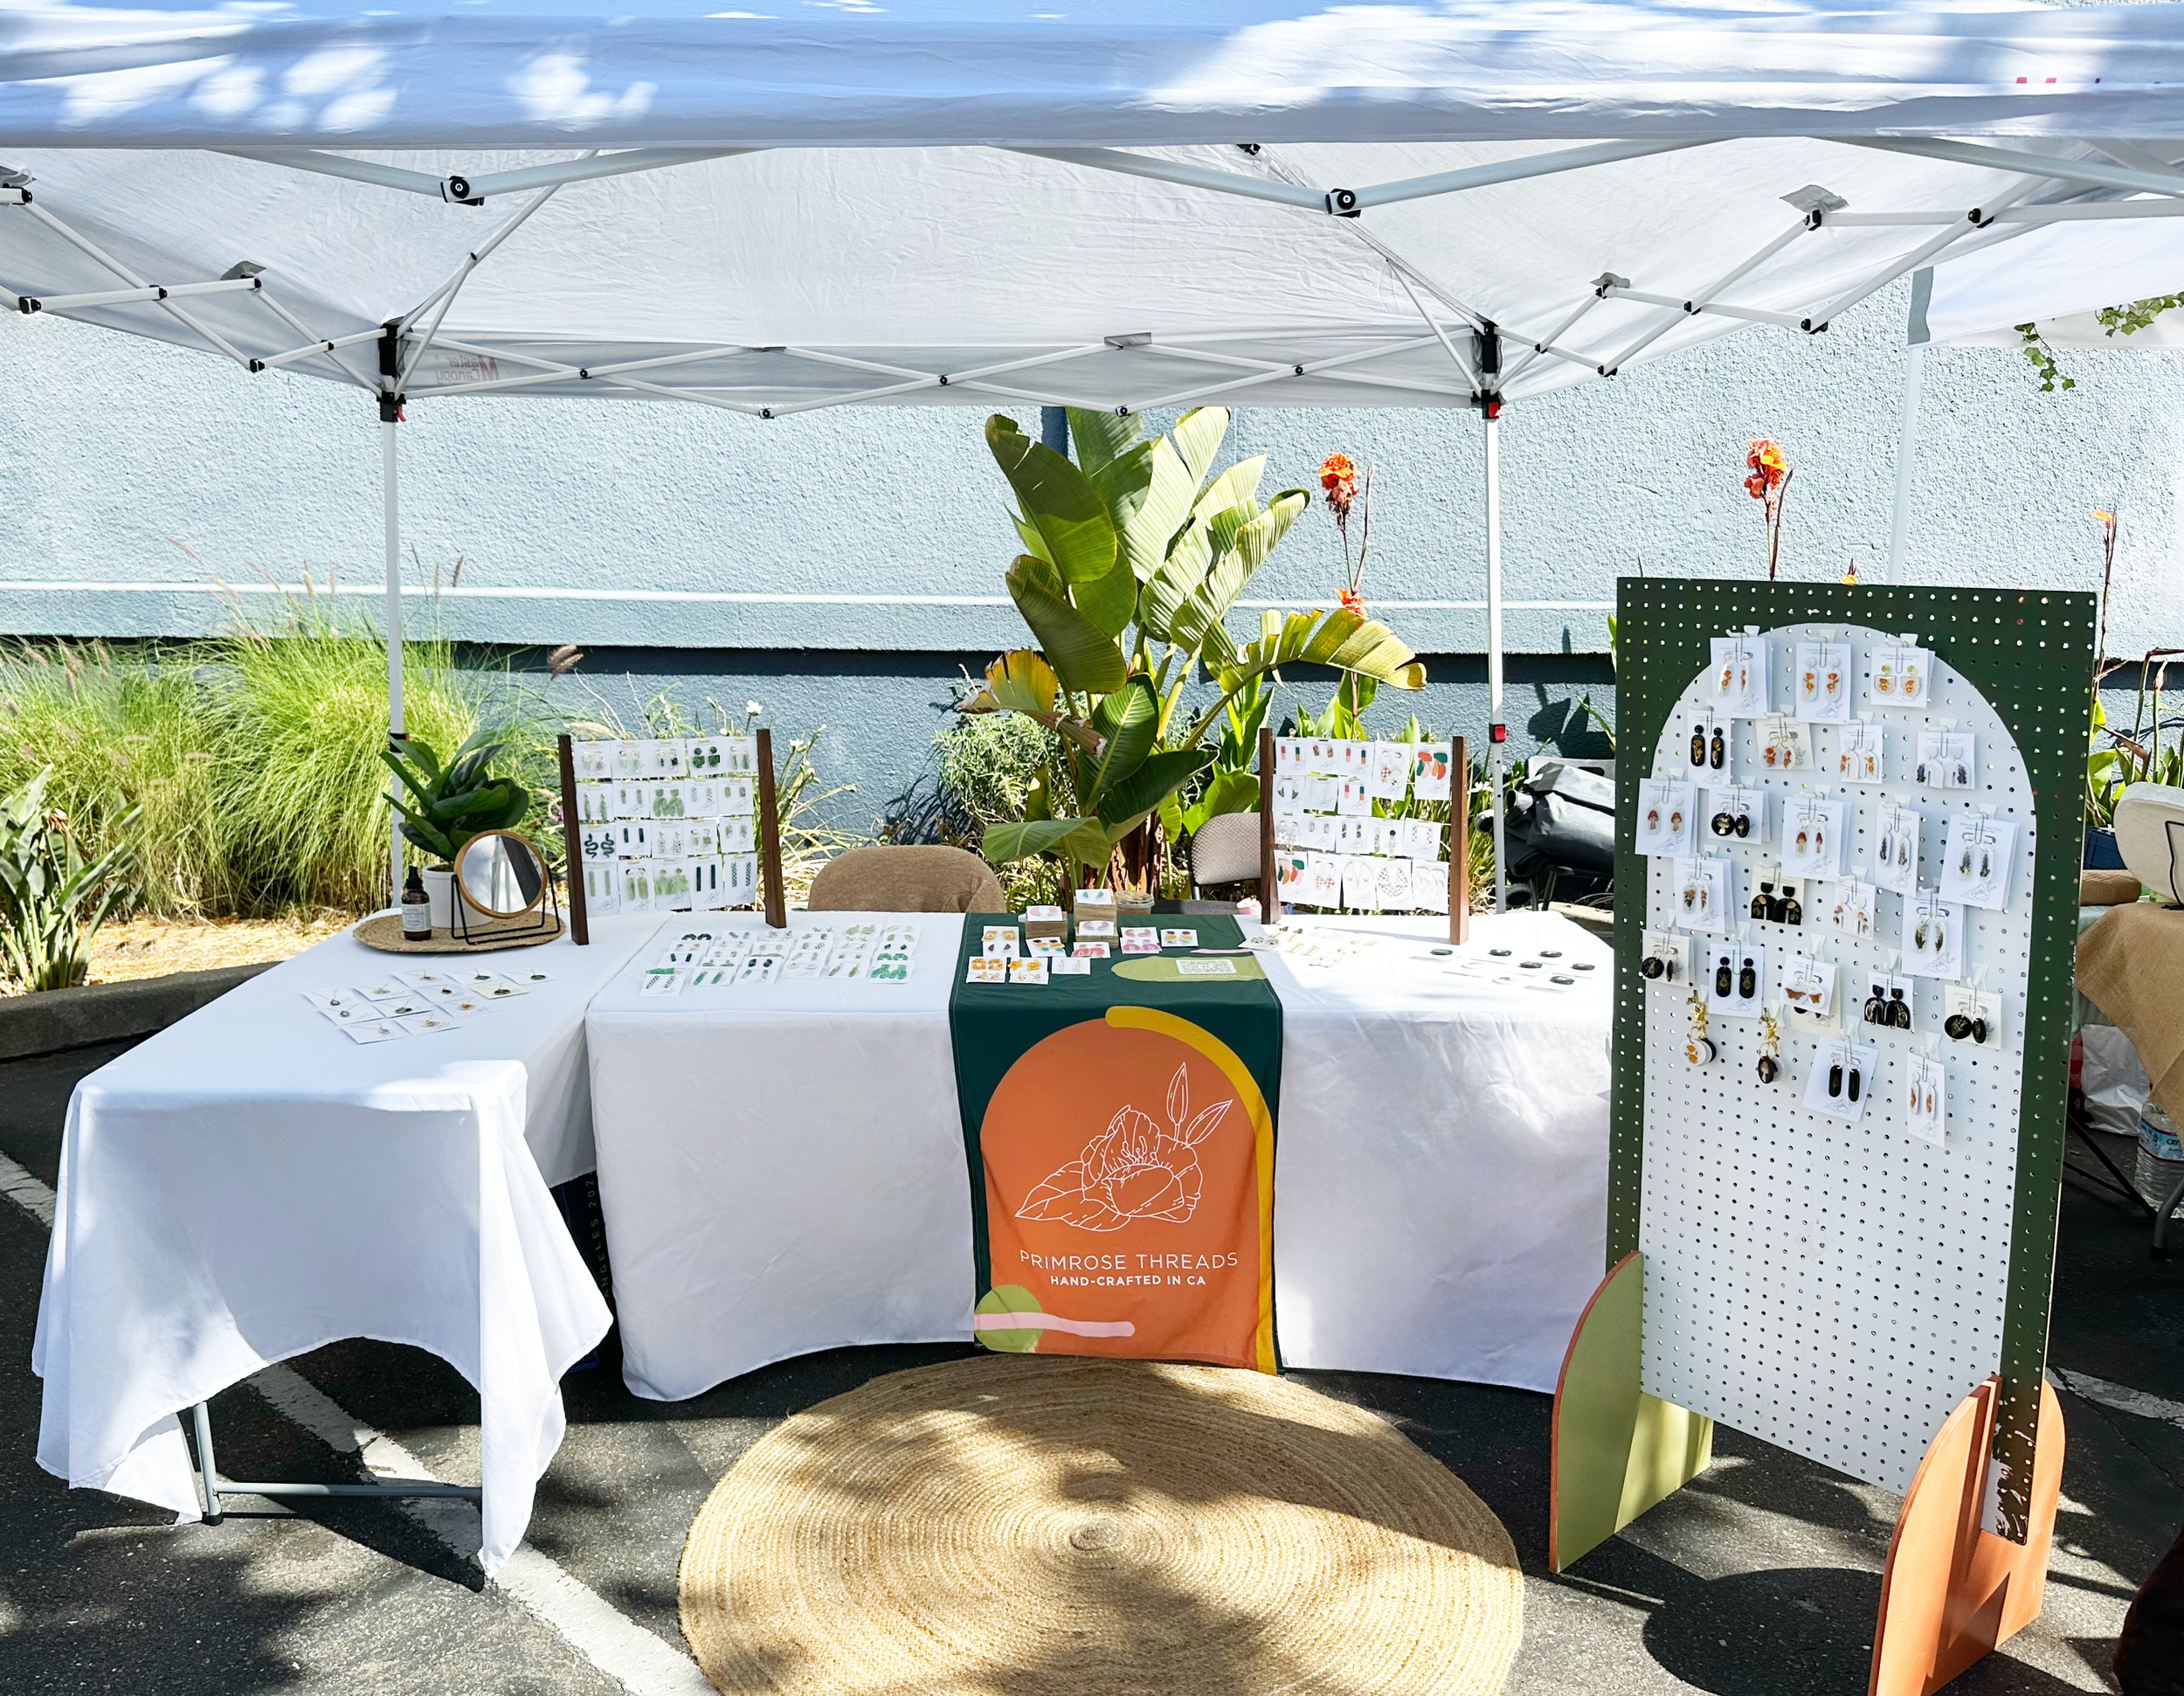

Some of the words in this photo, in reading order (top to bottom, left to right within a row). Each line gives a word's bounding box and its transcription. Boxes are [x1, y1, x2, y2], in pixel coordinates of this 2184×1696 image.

[591, 1218, 609, 1298] ANGELES
[1019, 1249, 1126, 1270] PRIMROSE
[1136, 1251, 1238, 1269] THREADS
[1050, 1275, 1161, 1286] HAND-CRAFTED
[1167, 1275, 1180, 1285] IN
[1186, 1275, 1206, 1285] CA
